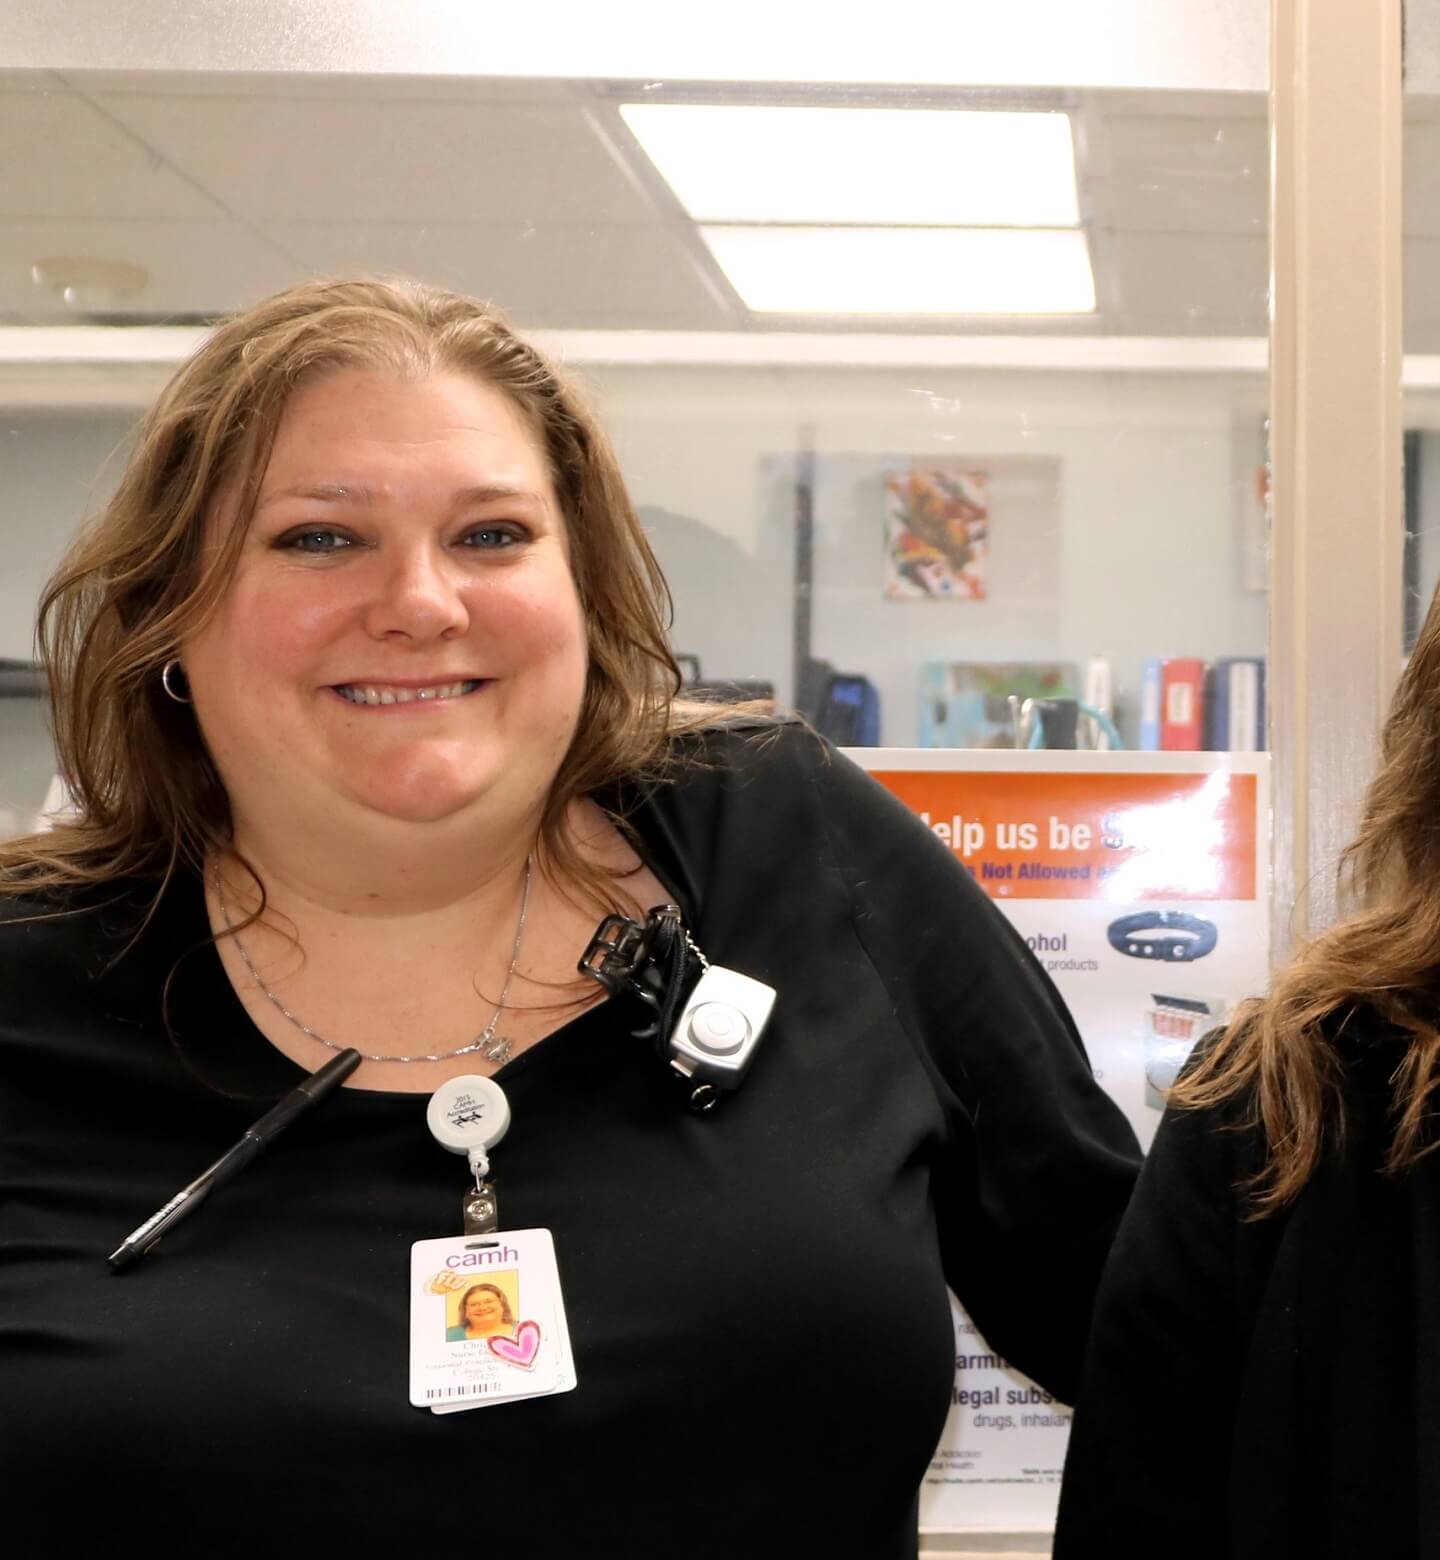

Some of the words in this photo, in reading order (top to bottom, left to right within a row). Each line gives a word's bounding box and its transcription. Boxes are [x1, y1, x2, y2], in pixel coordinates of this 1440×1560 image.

[996, 822, 1038, 849] us
[1050, 815, 1092, 850] be
[981, 863, 1012, 879] Not
[1018, 862, 1091, 880] Allowed
[1024, 933, 1067, 951] ohol
[1047, 958, 1099, 972] products
[445, 1246, 519, 1268] camh
[953, 1385, 999, 1409] legal
[973, 1412, 1017, 1430] drugs,
